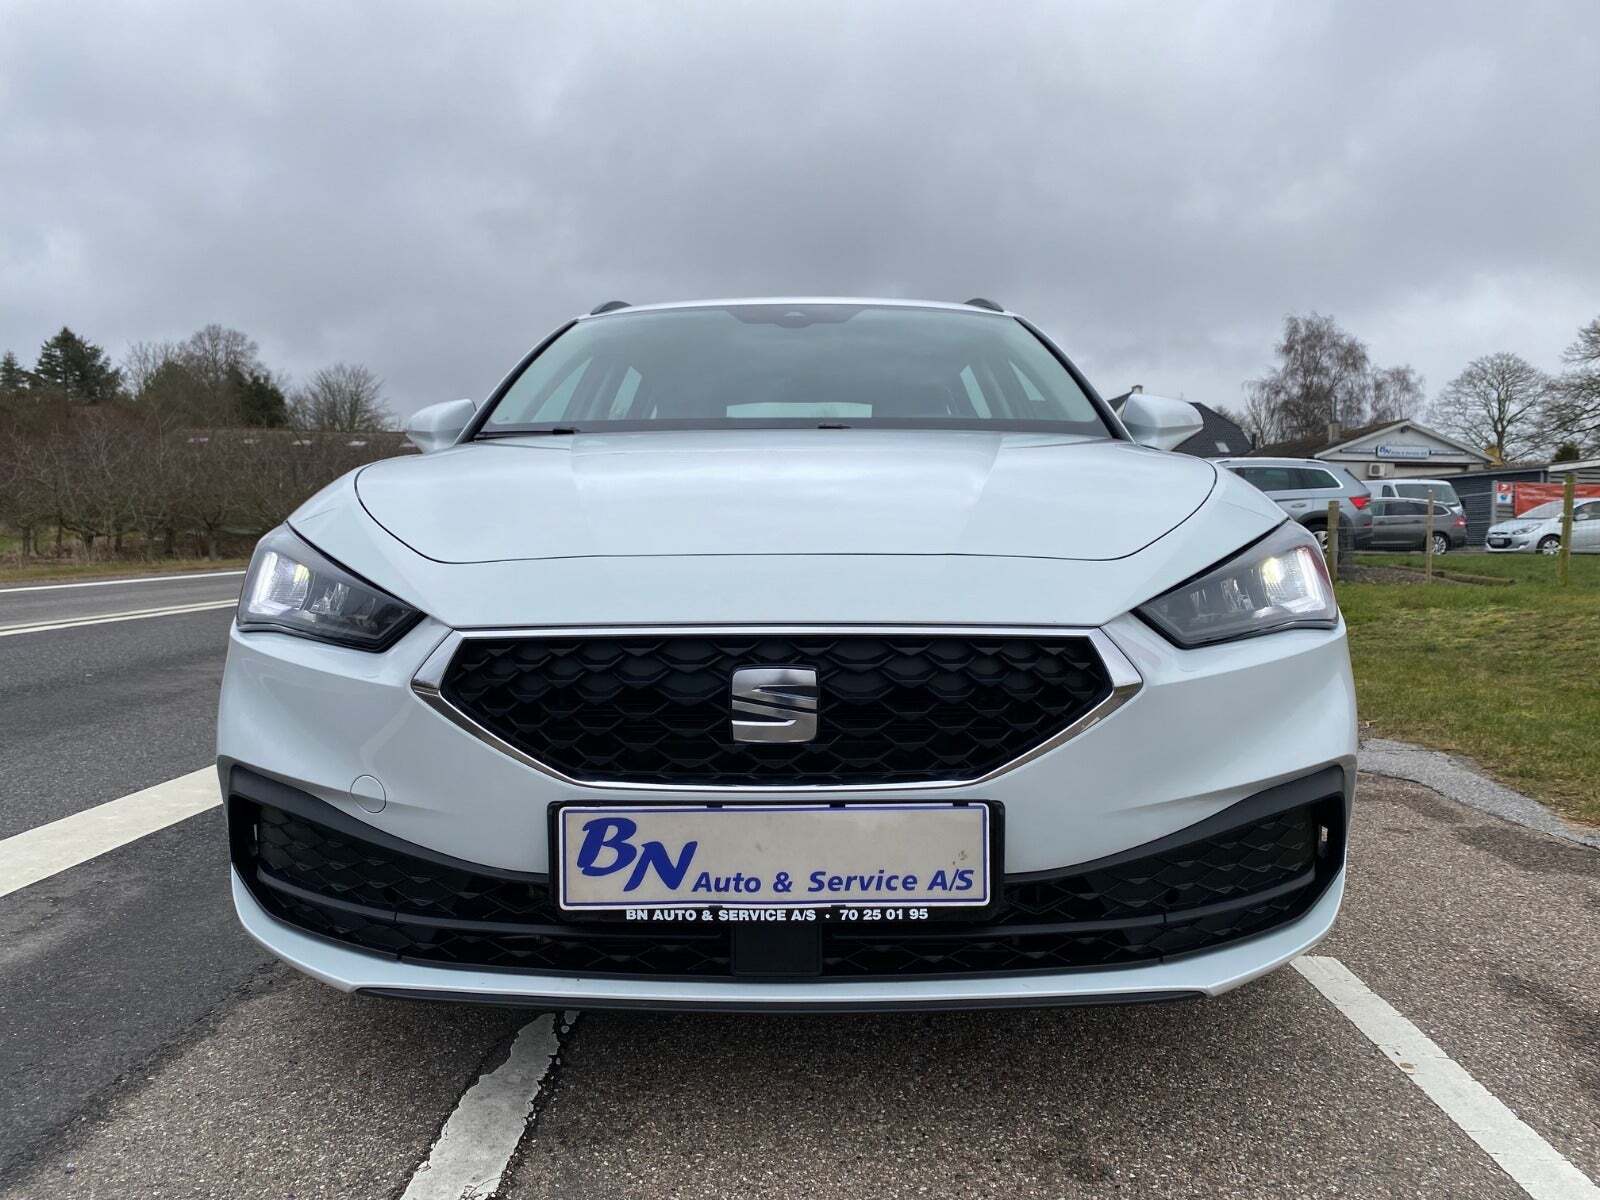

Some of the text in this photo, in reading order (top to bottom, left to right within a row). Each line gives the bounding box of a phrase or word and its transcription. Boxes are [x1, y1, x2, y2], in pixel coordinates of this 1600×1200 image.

[577, 817, 975, 893] BN Auto & Service A/S
[626, 908, 929, 921] BN AUTO & SERVICE A/S 70 25 01 95
